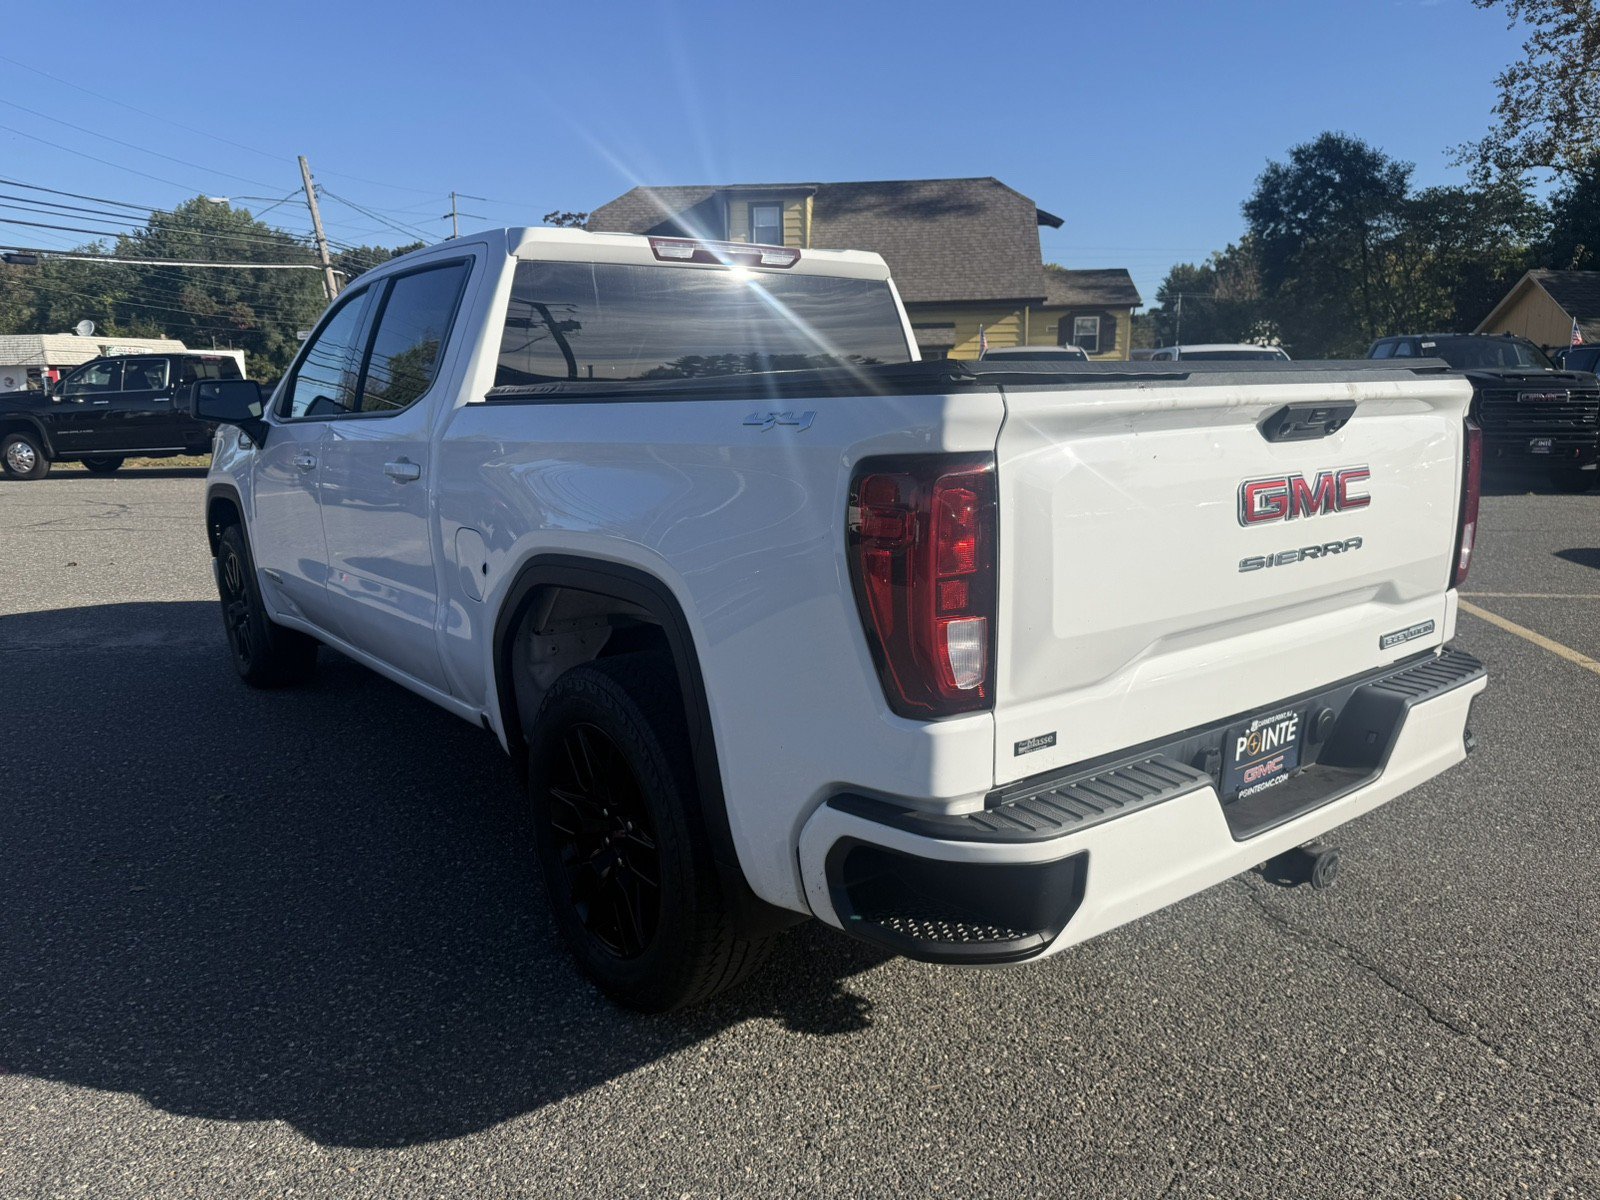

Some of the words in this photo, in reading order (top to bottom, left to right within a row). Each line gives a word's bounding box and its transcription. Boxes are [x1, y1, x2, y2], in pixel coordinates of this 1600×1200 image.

[1237, 464, 1371, 527] GMC
[1239, 536, 1363, 573] SIERRA
[1235, 718, 1299, 761] POINTE
[1243, 755, 1284, 783] GMC
